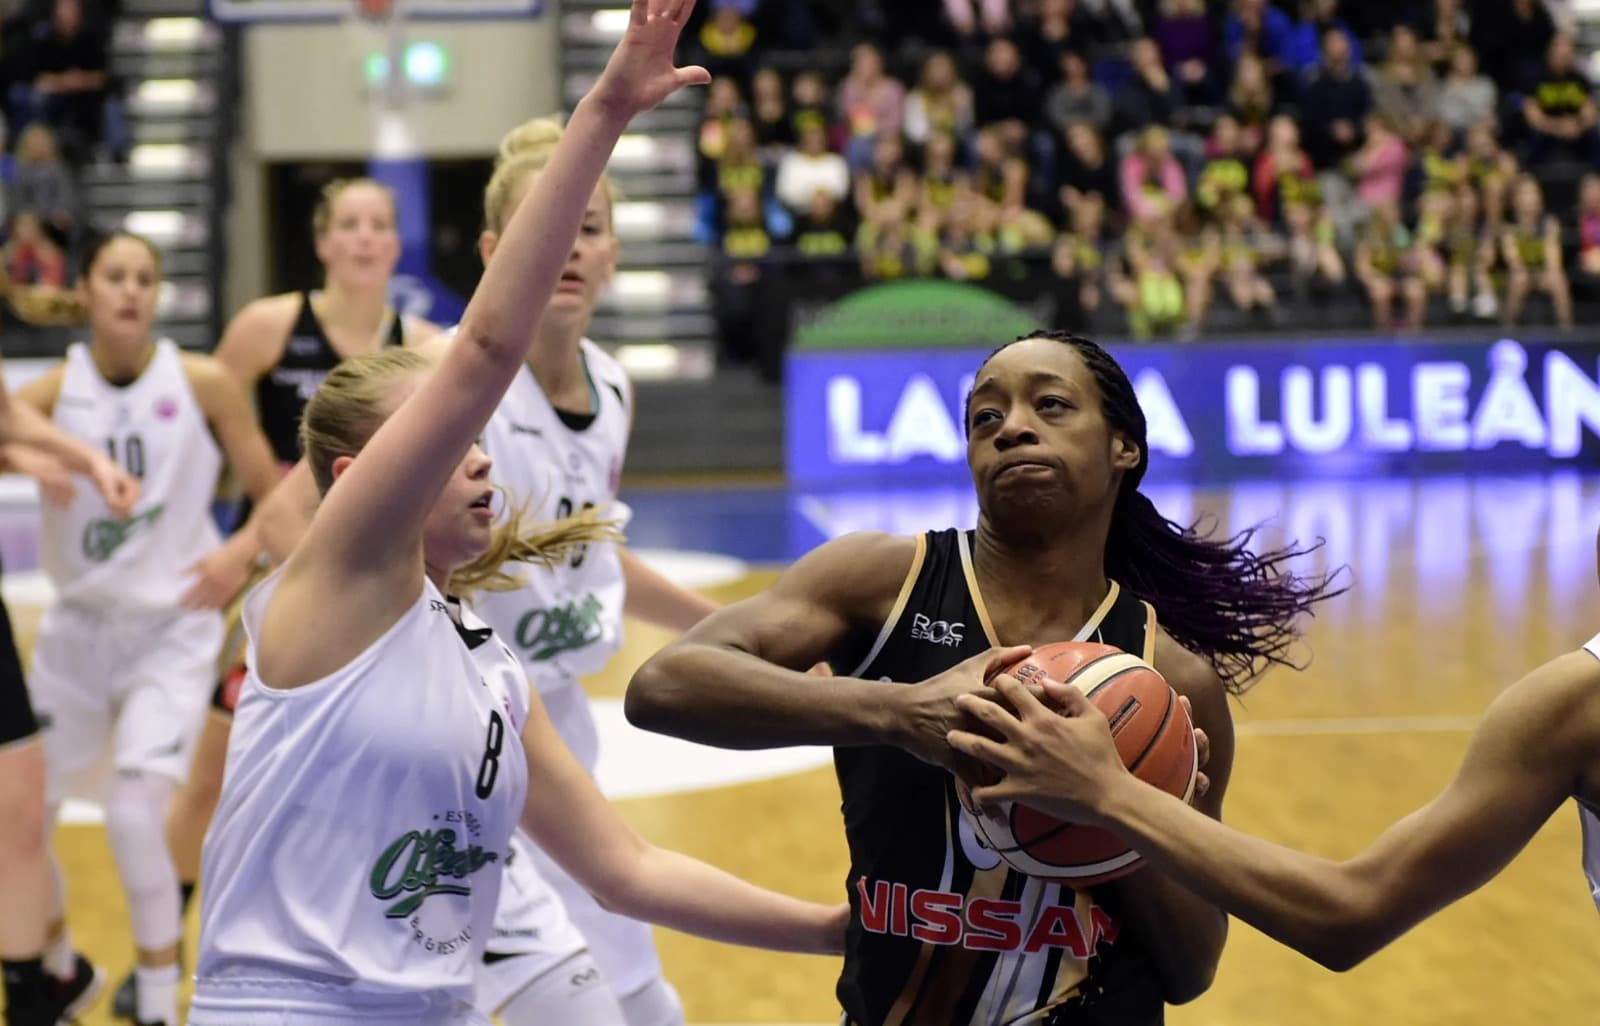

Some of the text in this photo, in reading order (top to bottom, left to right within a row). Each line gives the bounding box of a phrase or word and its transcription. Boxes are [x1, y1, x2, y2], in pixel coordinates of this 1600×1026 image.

[826, 370, 1196, 464] LAA
[475, 709, 504, 801] 8
[856, 875, 1120, 959] NISSAN
